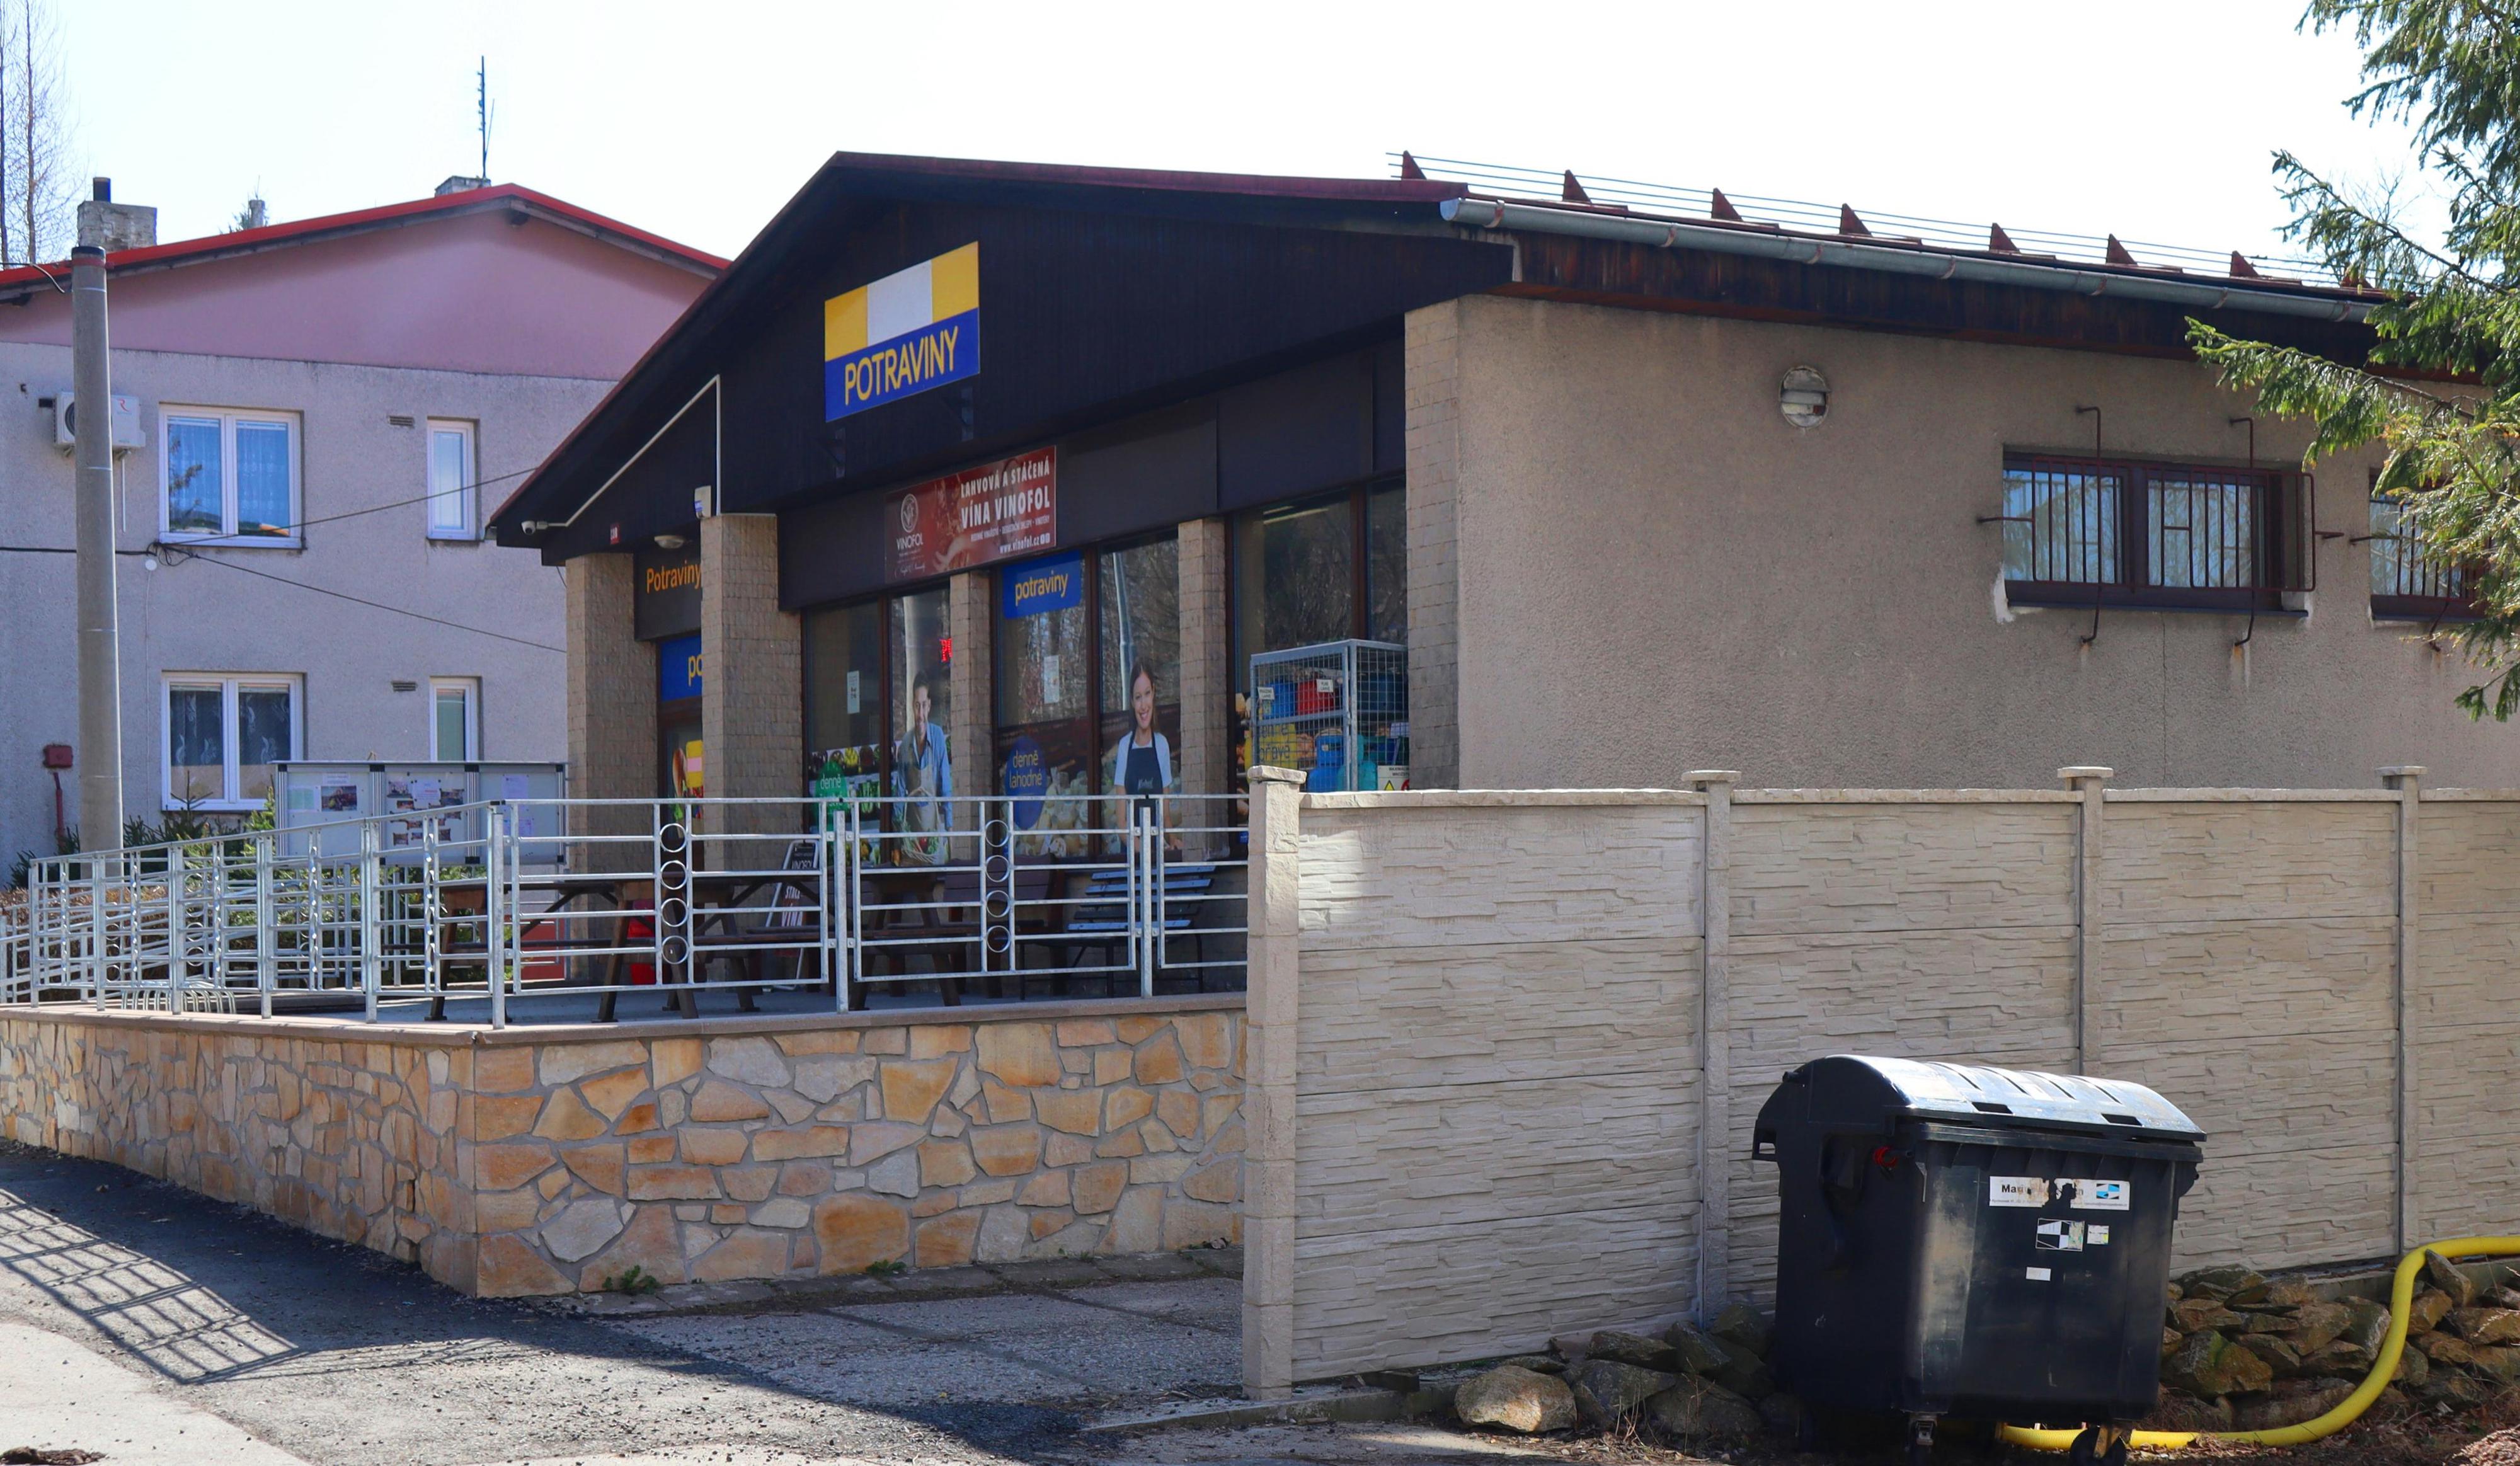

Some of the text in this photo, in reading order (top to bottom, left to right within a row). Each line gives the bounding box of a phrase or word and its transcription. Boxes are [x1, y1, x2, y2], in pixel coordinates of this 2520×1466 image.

[844, 325, 958, 405] POTRAVINY
[961, 455, 1050, 498] LAHVOVÁ A STÁČENÁ
[961, 485, 1050, 529] VÍNA VINOFOL
[896, 532, 924, 551] VINOFOL
[646, 559, 701, 593] Potraviny
[1015, 570, 1068, 606] potraviny
[1012, 749, 1039, 768] denně
[820, 774, 842, 789] denně
[1009, 768, 1043, 789] lahodné
